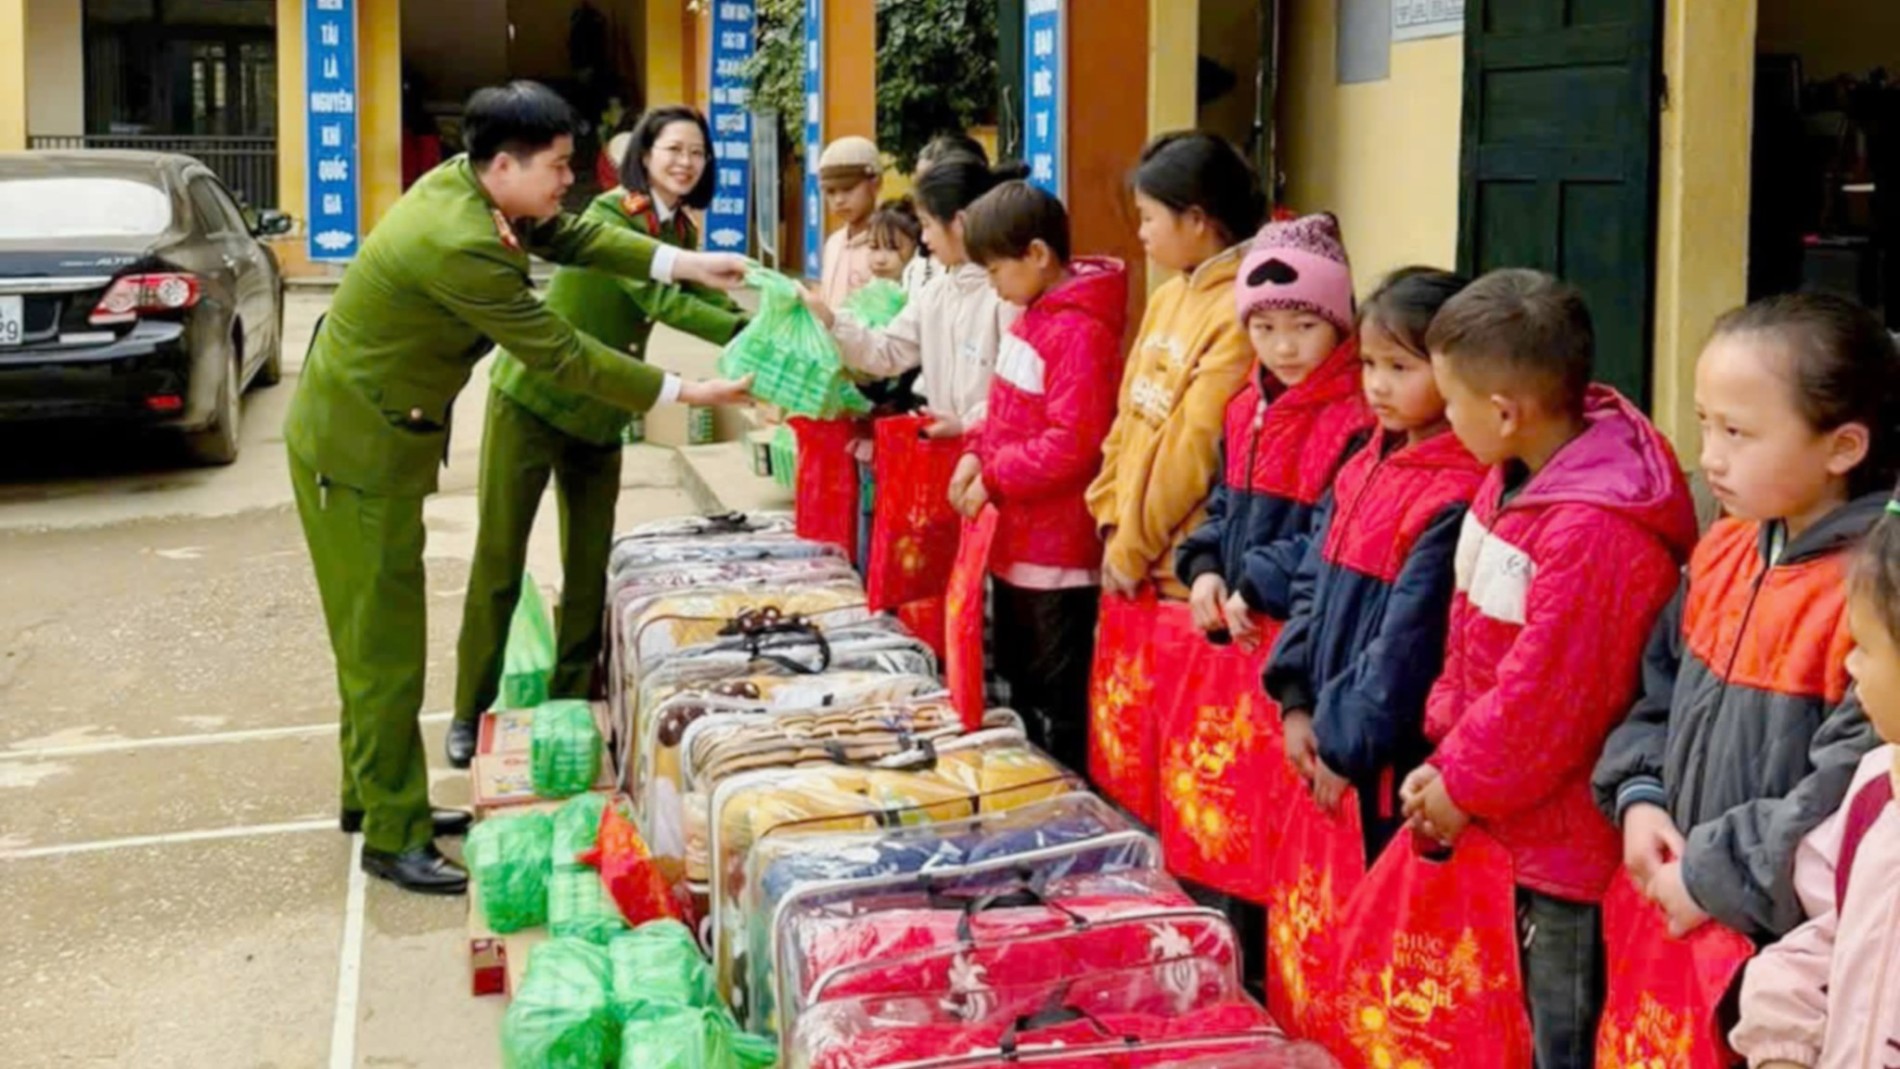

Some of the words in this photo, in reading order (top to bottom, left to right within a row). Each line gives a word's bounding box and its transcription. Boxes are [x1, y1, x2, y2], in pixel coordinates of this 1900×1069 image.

[323, 54, 339, 79] LÀ
[310, 88, 354, 113] NGUYÊN
[321, 122, 341, 147] KHÍ
[318, 154, 348, 182] QUỐC
[322, 193, 343, 215] GIA
